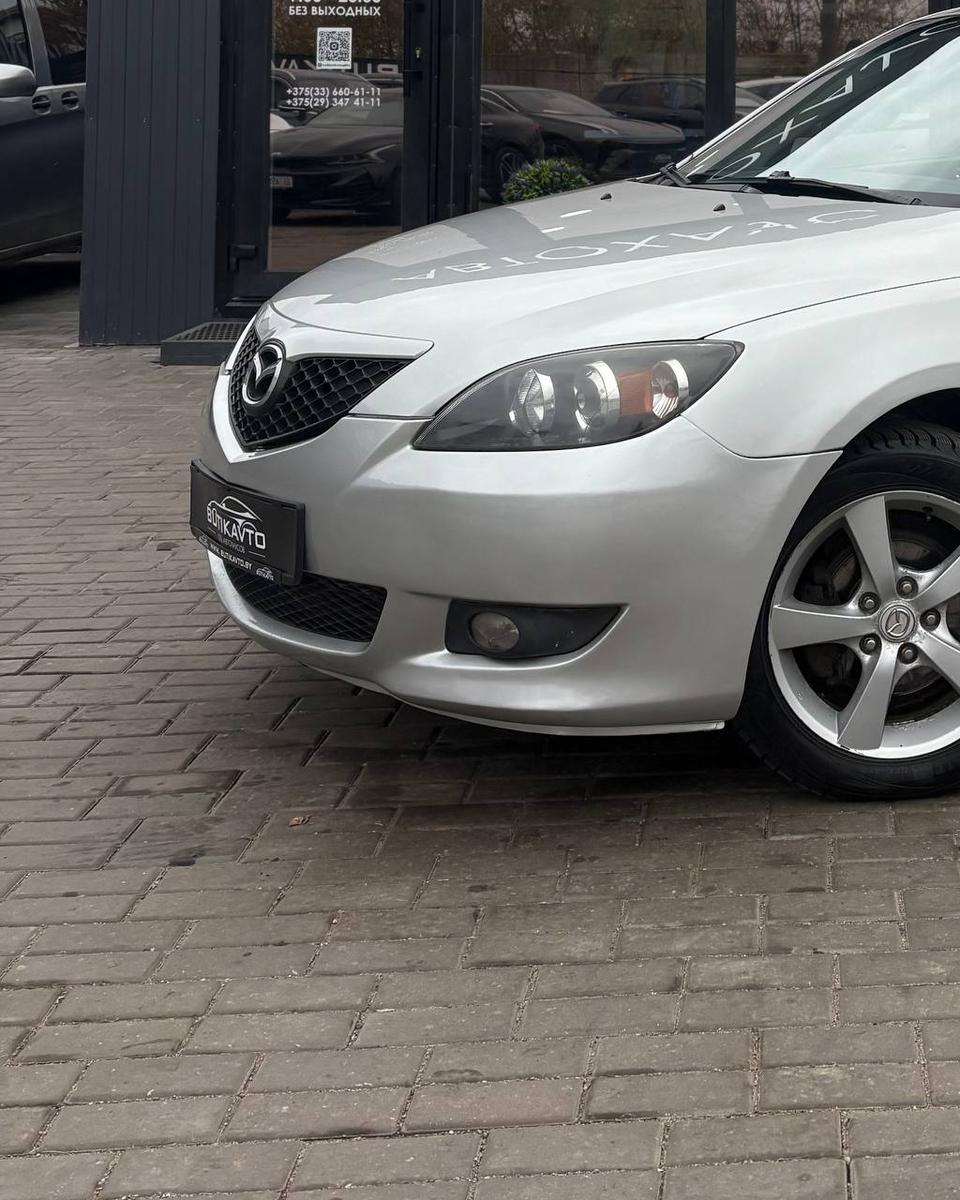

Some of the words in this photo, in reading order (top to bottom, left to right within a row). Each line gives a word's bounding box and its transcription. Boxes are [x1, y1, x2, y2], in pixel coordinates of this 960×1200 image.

[288, 6, 307, 16] БЕЗ
[311, 6, 381, 17] ВЫХОДНЫХ
[286, 87, 330, 98] +375(33)
[332, 87, 381, 97] 660-61-11
[286, 97, 330, 108] +375(29)
[207, 506, 266, 549] BUTIKAVTO
